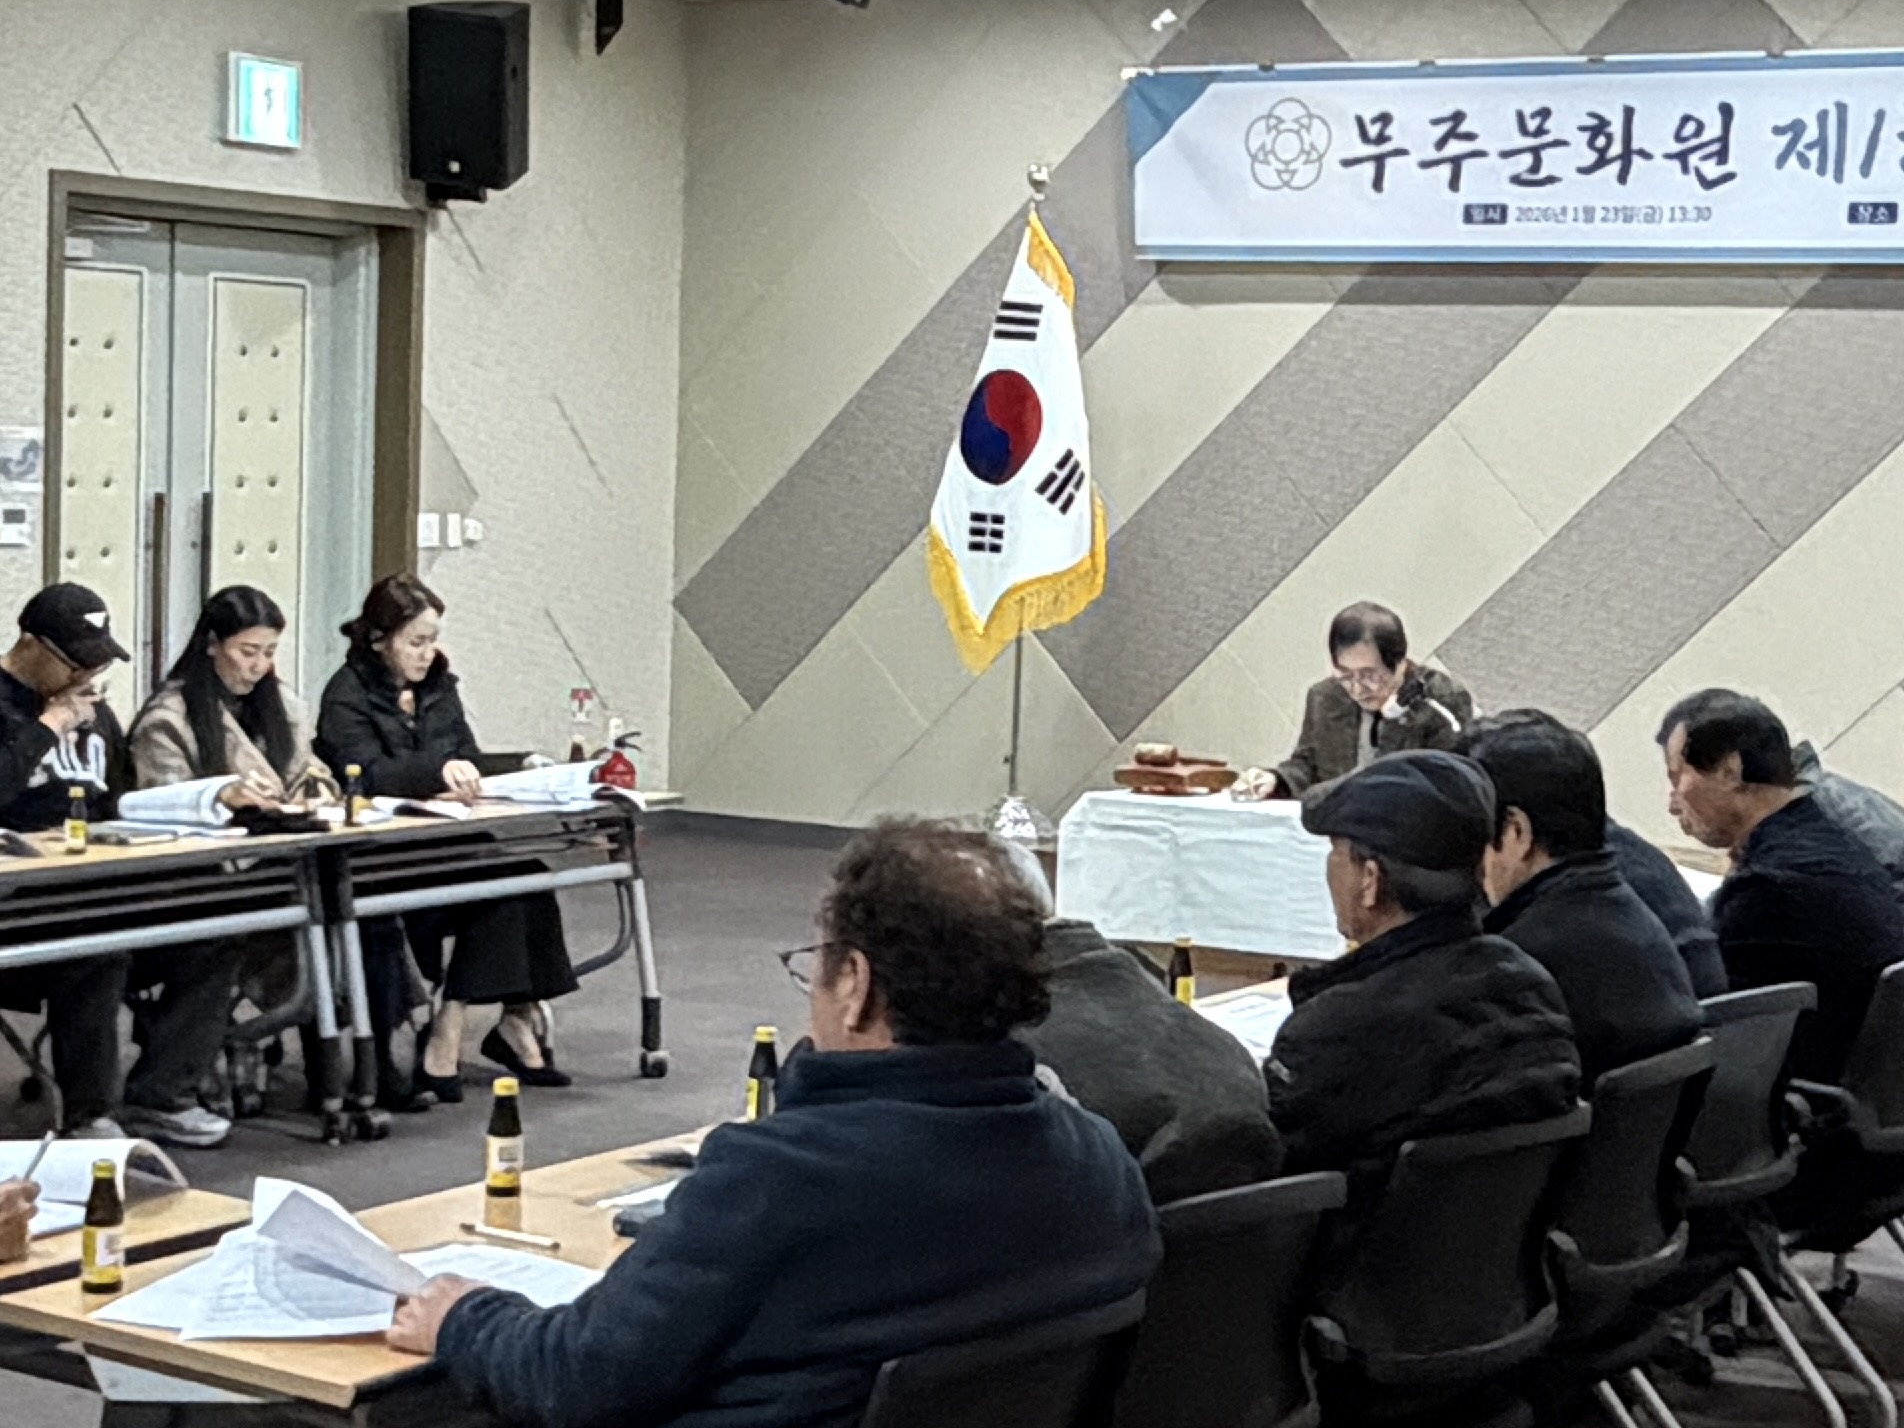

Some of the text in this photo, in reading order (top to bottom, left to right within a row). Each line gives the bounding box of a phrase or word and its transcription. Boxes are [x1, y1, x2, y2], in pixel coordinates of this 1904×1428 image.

[1339, 102, 1738, 192] 무주문화원
[1514, 205, 1568, 224] 2026년
[1572, 205, 1596, 224] 1월
[1668, 205, 1713, 223] 13:30
